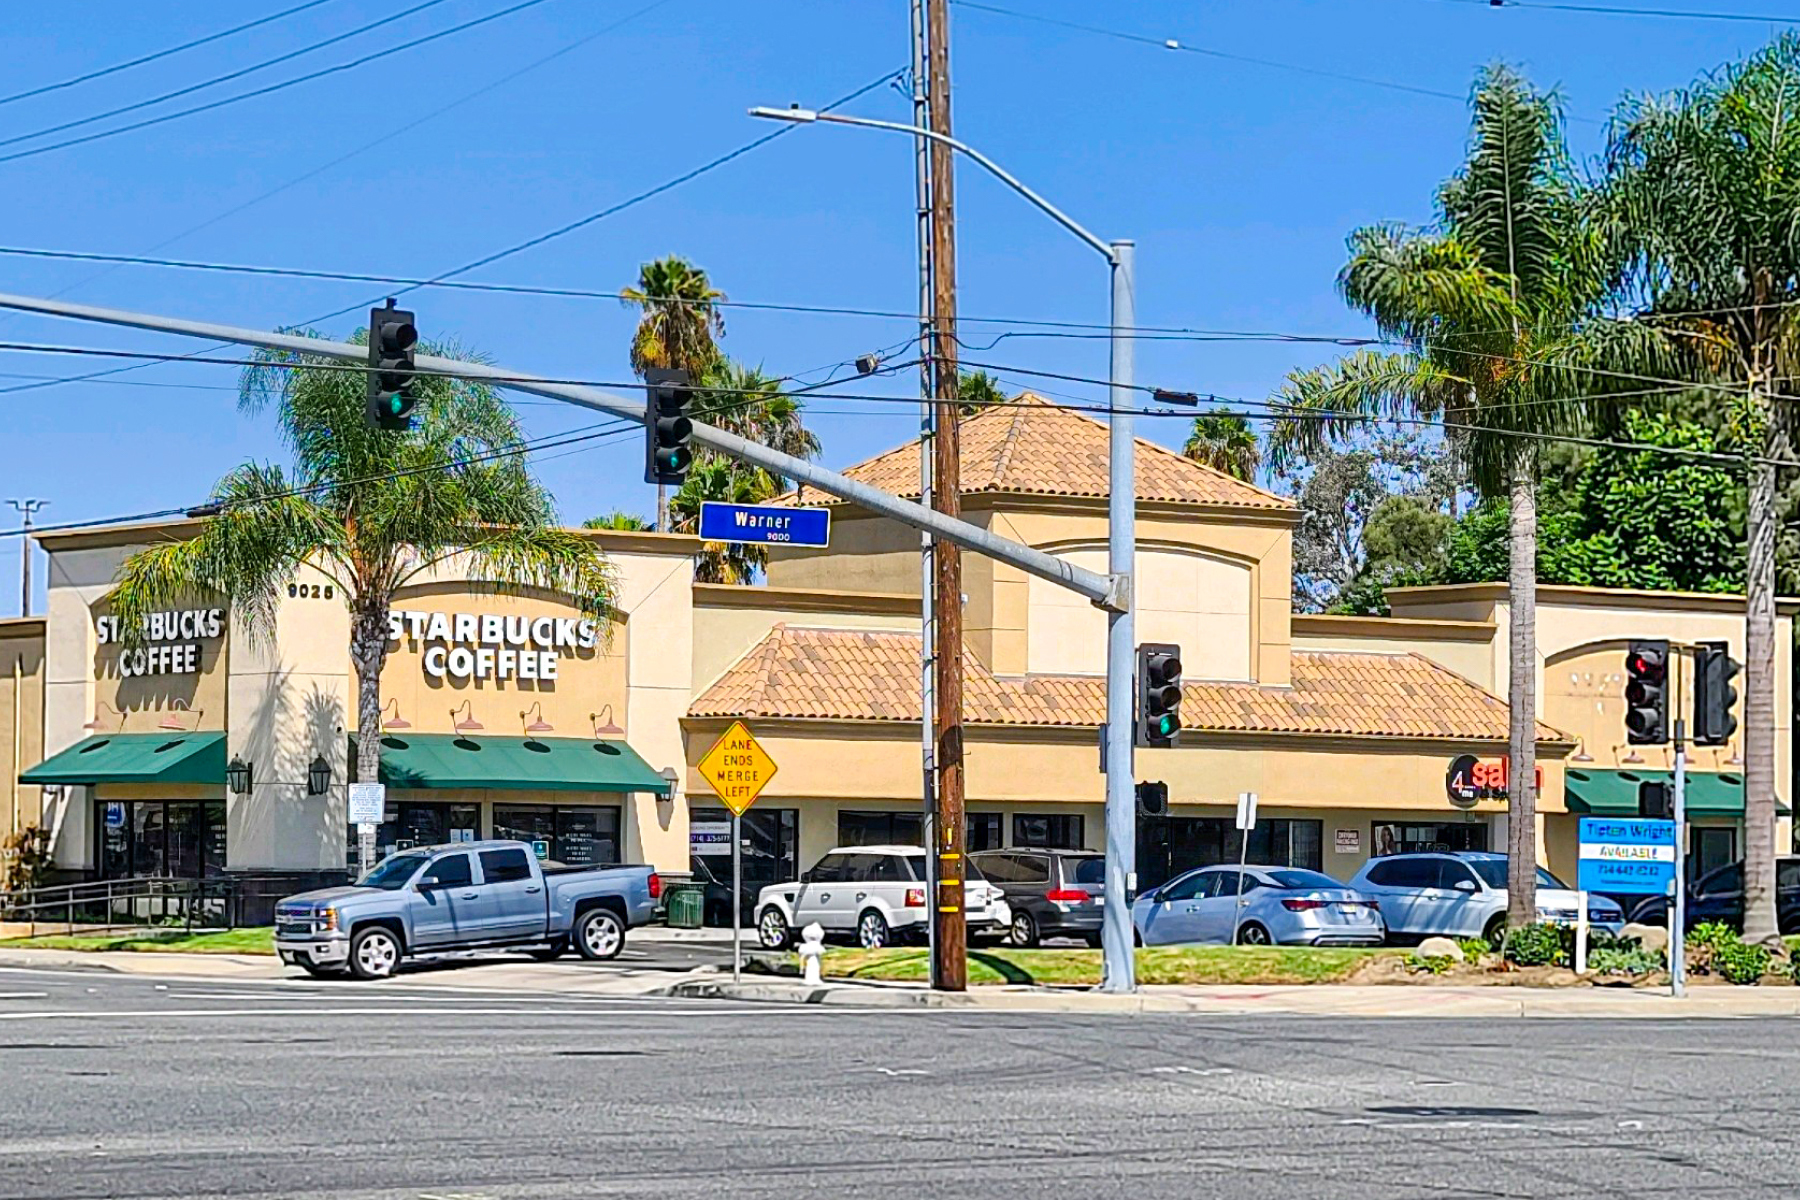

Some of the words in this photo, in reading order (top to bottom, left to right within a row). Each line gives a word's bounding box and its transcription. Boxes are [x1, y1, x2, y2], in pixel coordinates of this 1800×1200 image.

[735, 511, 791, 529] Warner
[767, 532, 790, 541] 9000
[97, 608, 221, 644] STRBUCKS
[386, 610, 598, 648] STARBUCKS
[120, 644, 196, 677] COFFEE
[425, 646, 559, 680] COFFEE
[723, 740, 753, 751] LANE
[724, 754, 753, 767] ENDS
[717, 770, 759, 782] MERGE
[1451, 771, 1463, 794] 4
[725, 786, 751, 798] LEFT
[1630, 825, 1674, 840] Wright
